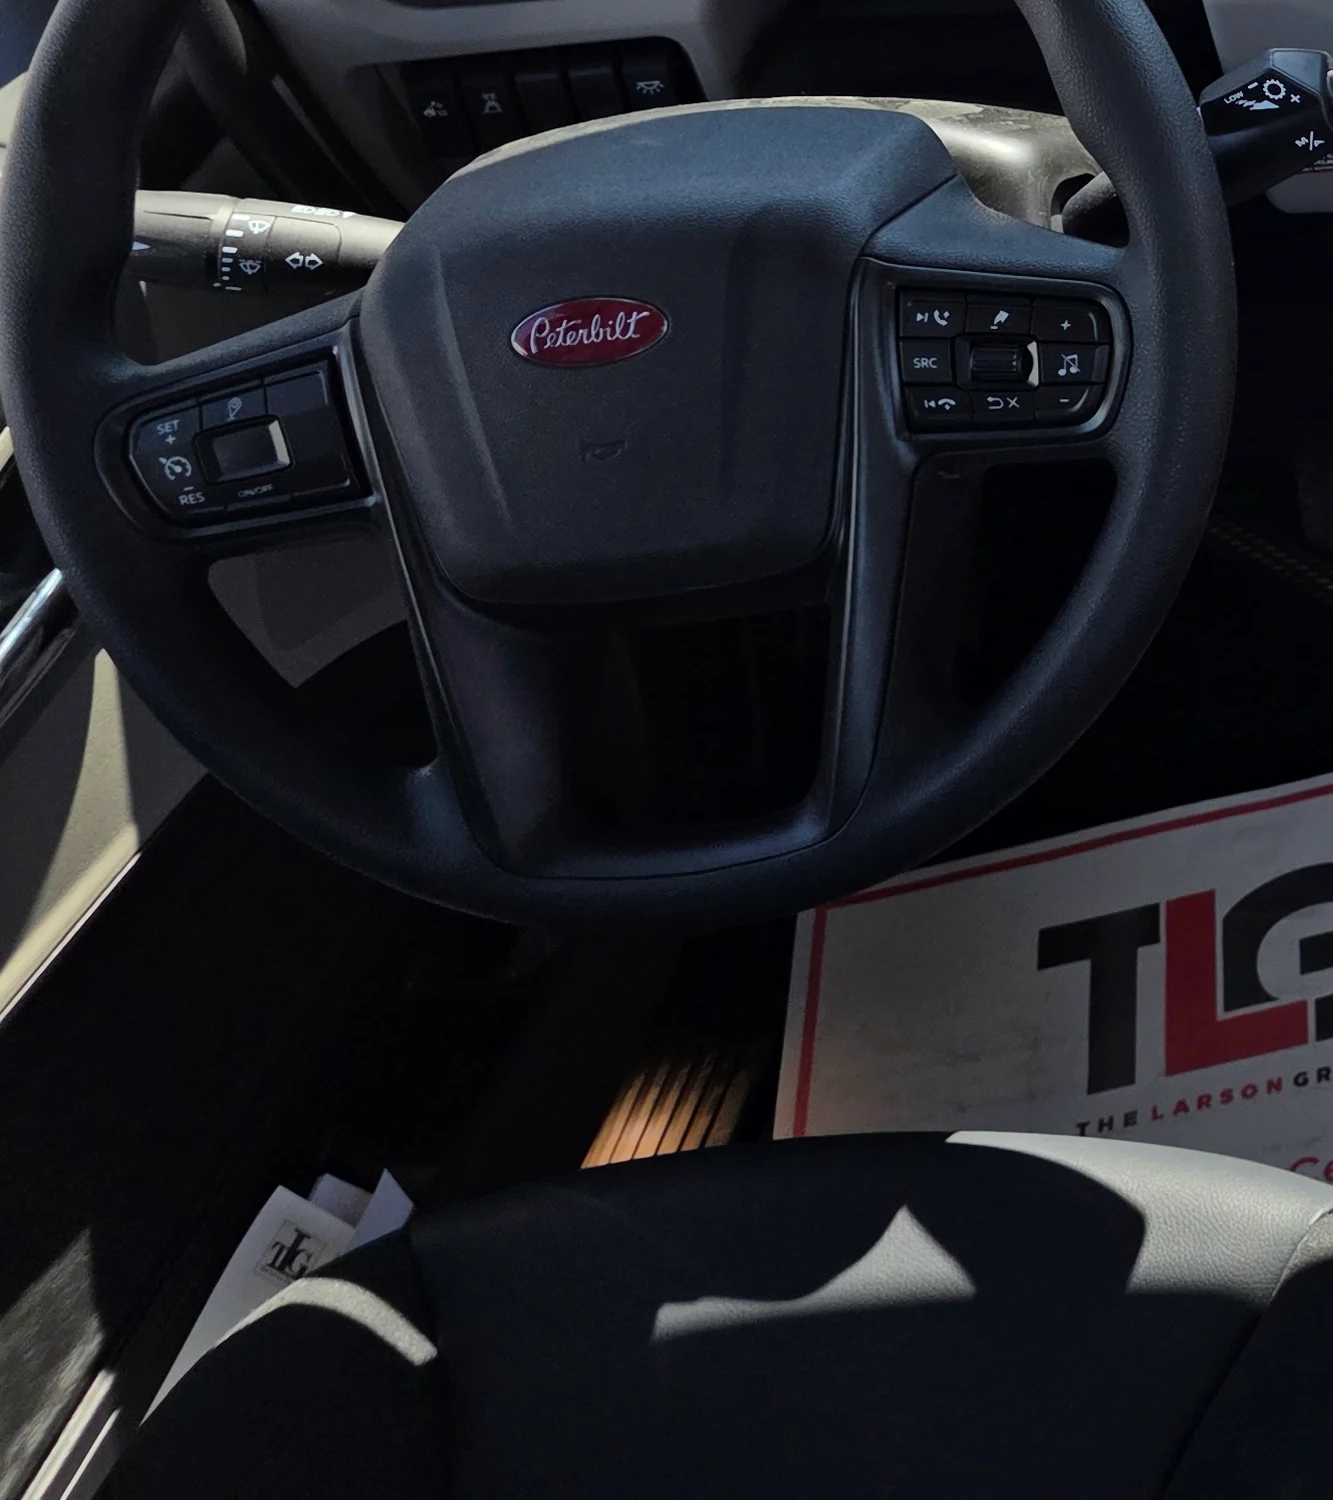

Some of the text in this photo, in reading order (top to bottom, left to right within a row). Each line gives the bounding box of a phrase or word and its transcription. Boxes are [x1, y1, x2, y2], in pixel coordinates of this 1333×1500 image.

[1224, 91, 1244, 104] LOW
[530, 311, 650, 354] Peterbilt
[913, 358, 938, 369] SRC
[156, 420, 180, 436] SET
[178, 492, 205, 506] RES
[1076, 1110, 1139, 1137] THE
[1150, 1077, 1284, 1121] LARSON
